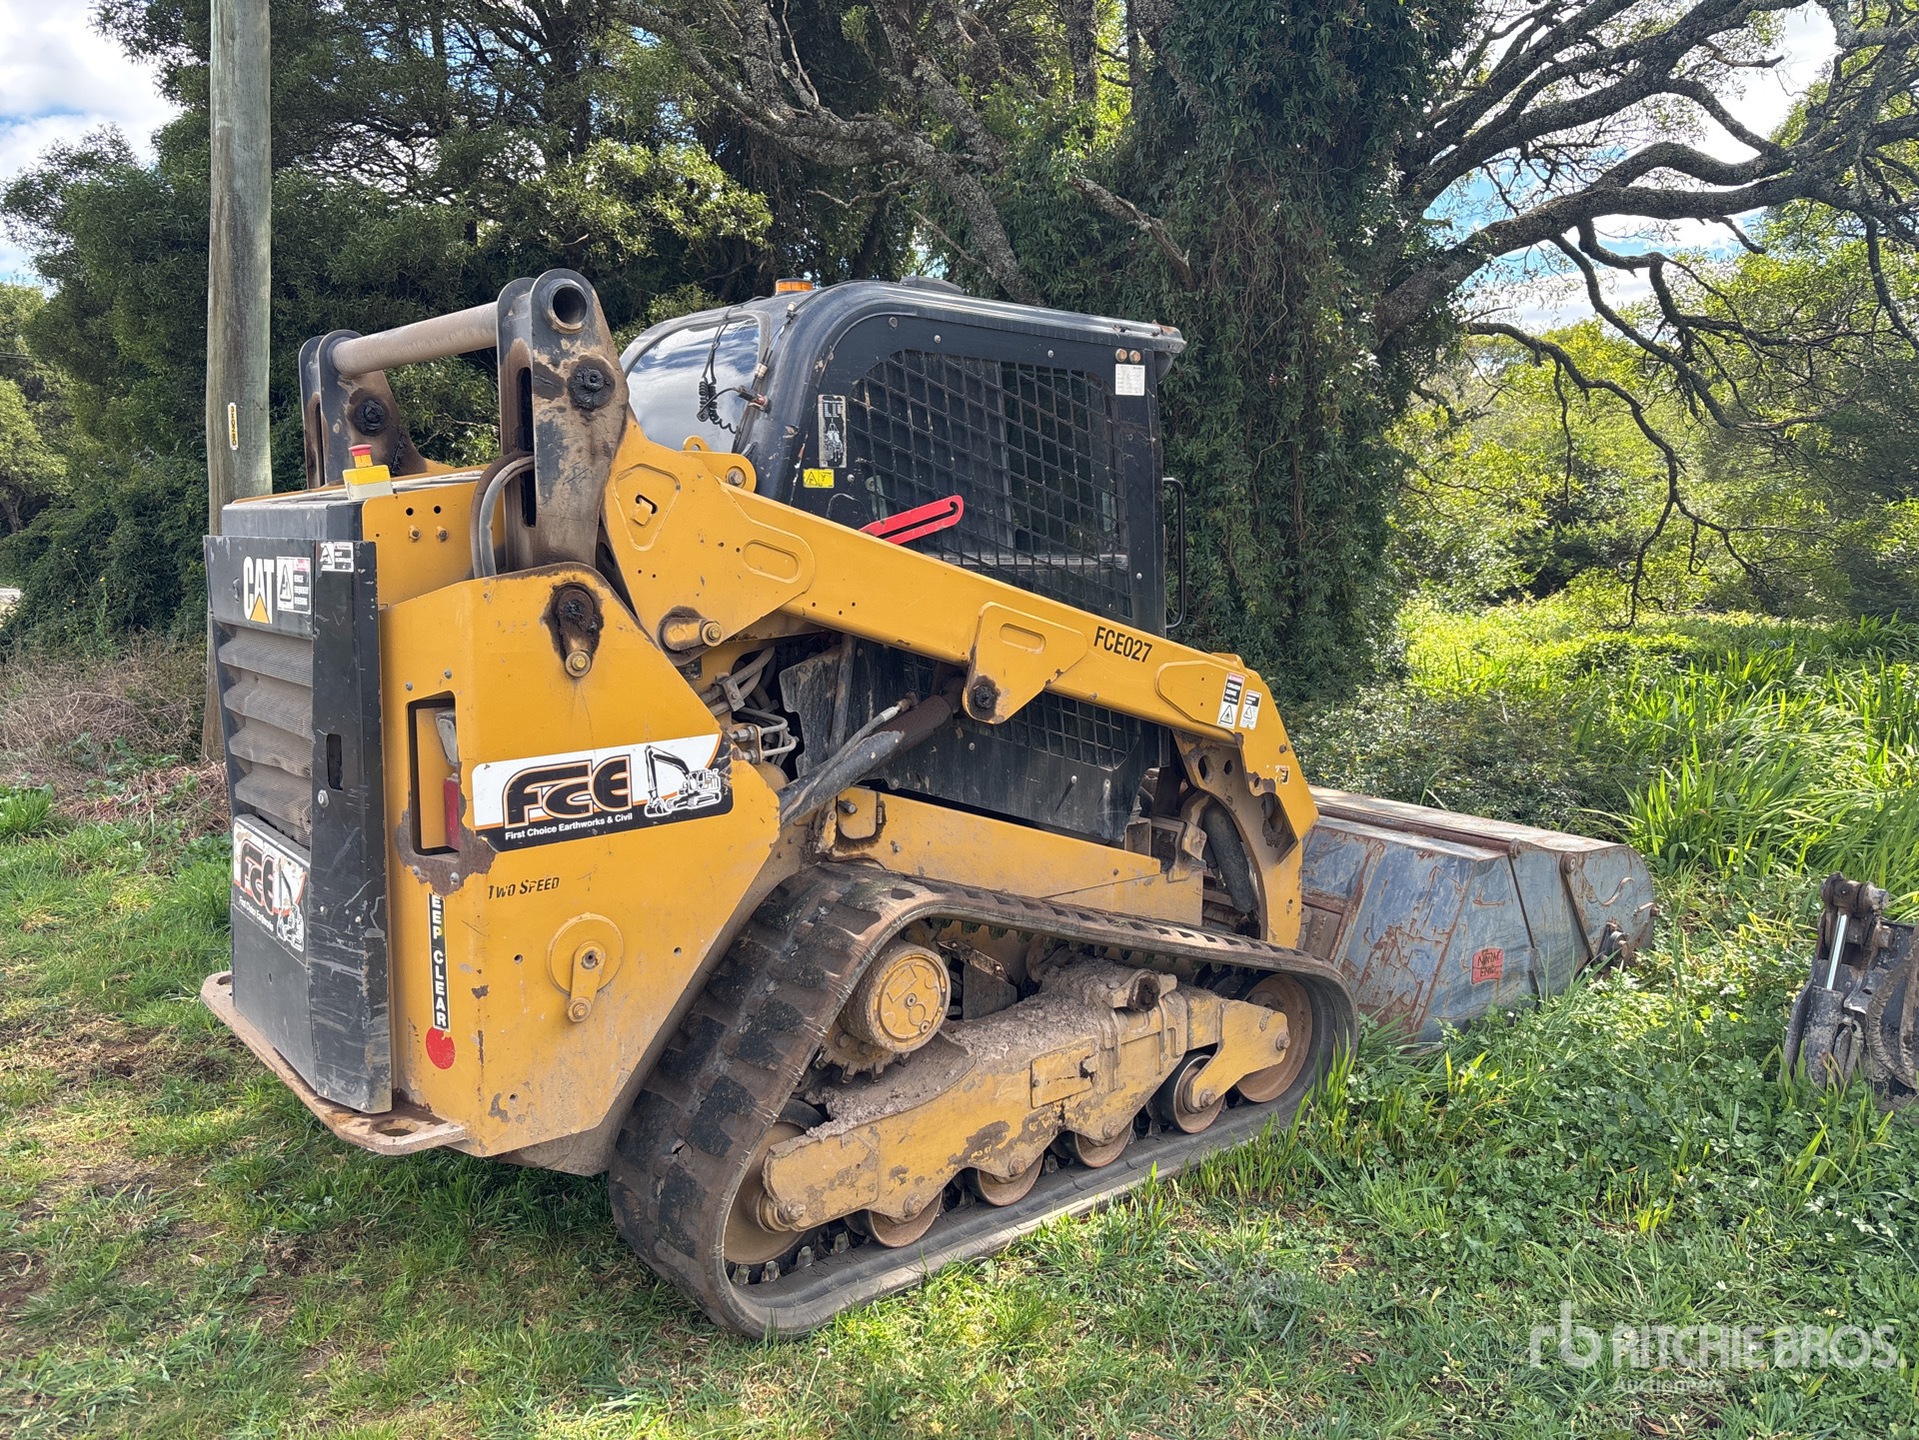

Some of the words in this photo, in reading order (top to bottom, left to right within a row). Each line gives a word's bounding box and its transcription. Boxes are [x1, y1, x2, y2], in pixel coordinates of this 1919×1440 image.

[243, 556, 274, 624] CAT
[1094, 626, 1153, 663] FCE027
[503, 754, 632, 829] FCE
[505, 830, 525, 840] First
[527, 825, 557, 836] Choice
[558, 817, 605, 831] Earthworks
[607, 816, 613, 824] &
[615, 812, 633, 823] Civil
[431, 894, 443, 940] EEP
[433, 950, 447, 1027] CLEAR
